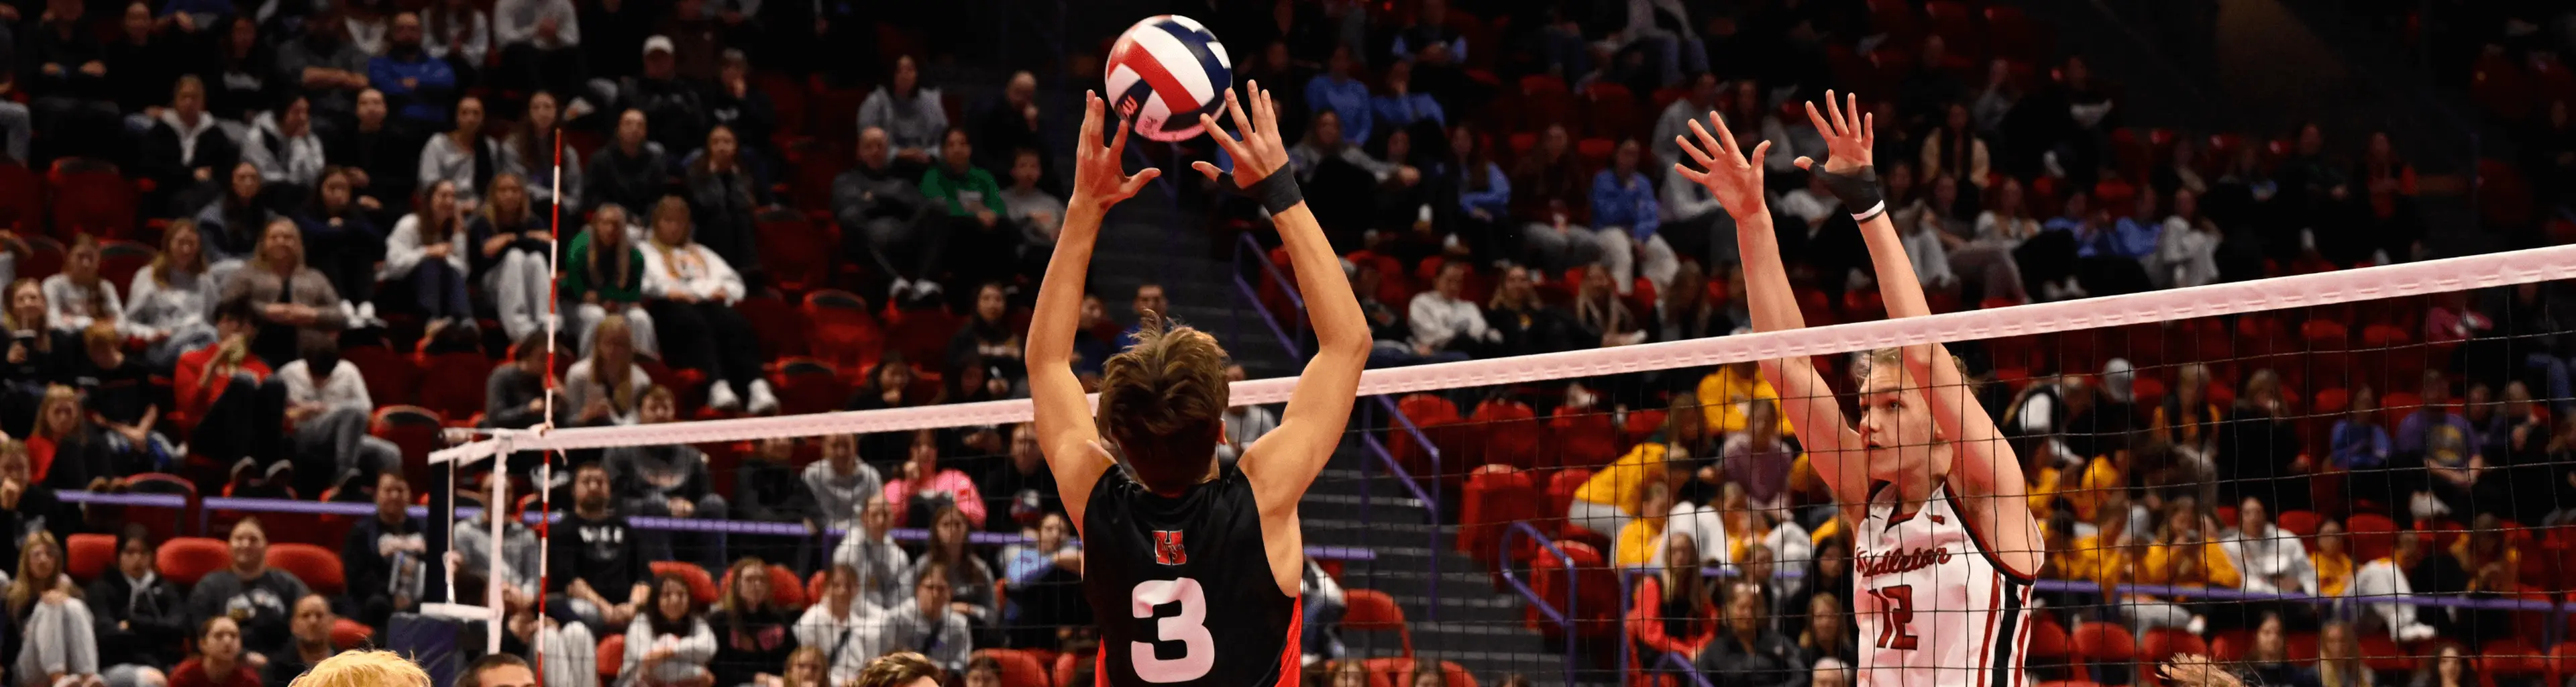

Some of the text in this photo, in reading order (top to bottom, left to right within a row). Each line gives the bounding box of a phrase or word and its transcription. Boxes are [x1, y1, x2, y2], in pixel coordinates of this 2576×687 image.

[1152, 529, 1187, 566] H
[1131, 577, 1215, 683] 3
[1868, 584, 1919, 650] 12
